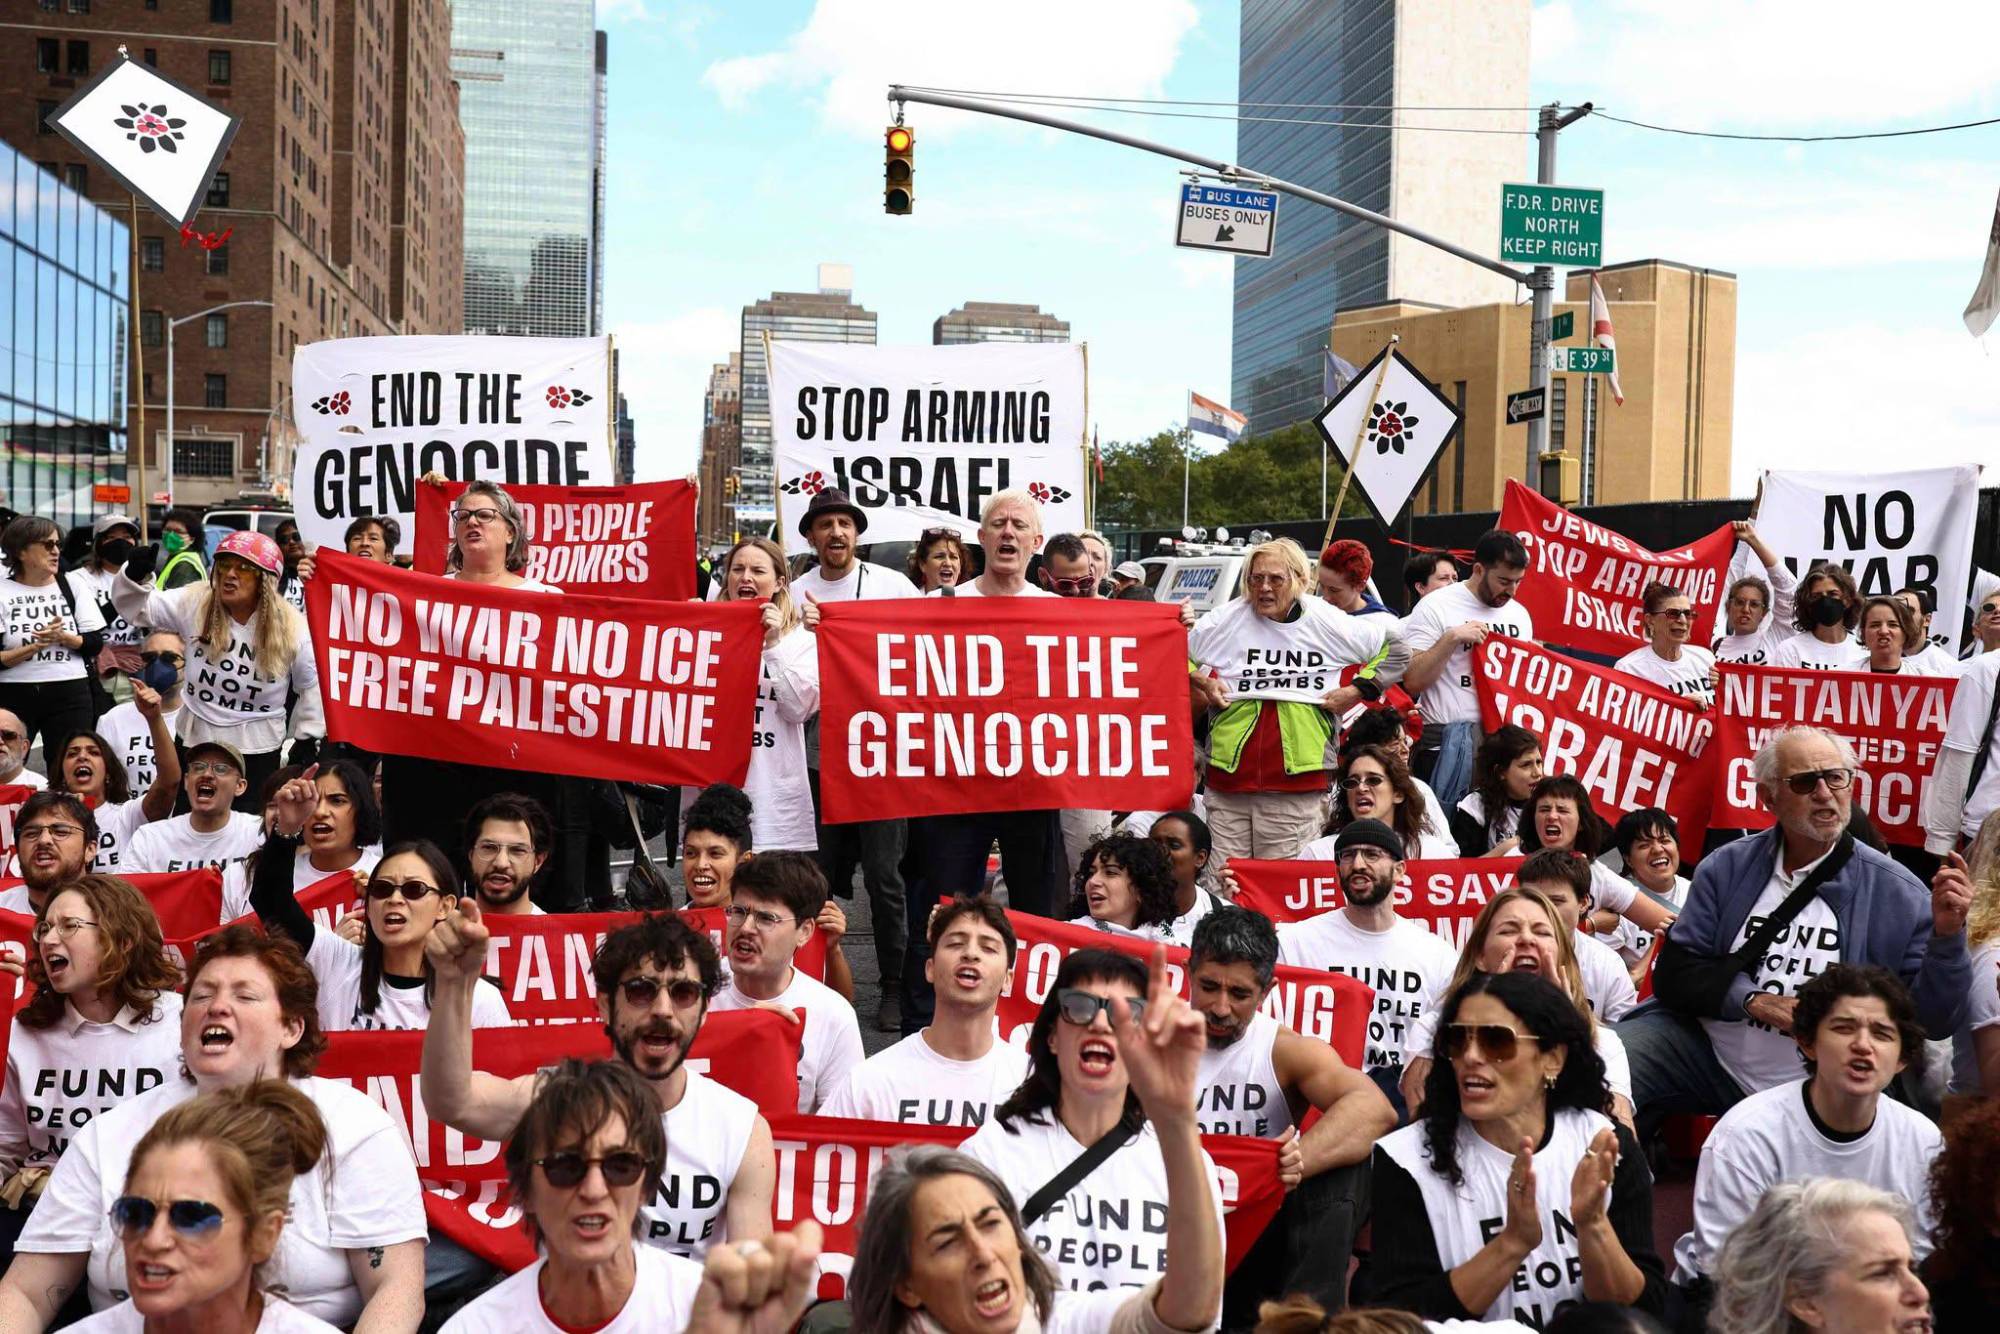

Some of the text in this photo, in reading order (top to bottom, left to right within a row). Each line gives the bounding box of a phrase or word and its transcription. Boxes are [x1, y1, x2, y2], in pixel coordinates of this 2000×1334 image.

[1206, 190, 1270, 207] BUS LANE
[1506, 193, 1599, 215] F.D.R. DRIVE
[1186, 205, 1268, 226] BUSES ONLY
[1525, 217, 1579, 235] NORTH
[1504, 237, 1599, 258] KEEP RIGHT
[1569, 351, 1610, 369] E 39 St
[372, 371, 522, 428] END THE
[796, 385, 1050, 444] STOP ARMING
[314, 439, 589, 519] GENOCIDE
[543, 501, 654, 542] PEOPLE
[1542, 511, 1628, 553] JEWS
[1823, 490, 1915, 551] NO
[524, 540, 649, 583] BOMBS
[1178, 568, 1216, 588] POLICE
[11, 604, 72, 621] FUND
[329, 583, 403, 647] NO
[415, 598, 542, 670] WAR
[551, 616, 629, 679] NO
[639, 624, 723, 688] ICE
[876, 633, 1140, 699] END THE
[1247, 648, 1324, 668] FUND
[199, 669, 263, 701] NOT
[1238, 676, 1325, 692] BOMBS
[1242, 668, 1328, 678] PEO
[1668, 677, 1712, 696] UND
[187, 682, 271, 713] BOMBS
[329, 646, 716, 751] FREE PALESTINE
[1484, 641, 1573, 701] STOP
[1576, 676, 1713, 760] ARMING
[848, 710, 1170, 777] GENOCIDE
[1747, 725, 1906, 764] WTED
[1285, 872, 1515, 910] JES SAY
[1328, 966, 1422, 994] UND
[1371, 998, 1422, 1019] PLE
[1369, 1022, 1405, 1044] OT
[34, 1068, 163, 1098] FUND
[1197, 1083, 1267, 1111] ND
[27, 1106, 113, 1129] PEO
[899, 1099, 1001, 1128] FUN
[650, 1175, 722, 1209] ND
[648, 1216, 717, 1244] PLE
[1513, 1257, 1584, 1292] EOP
